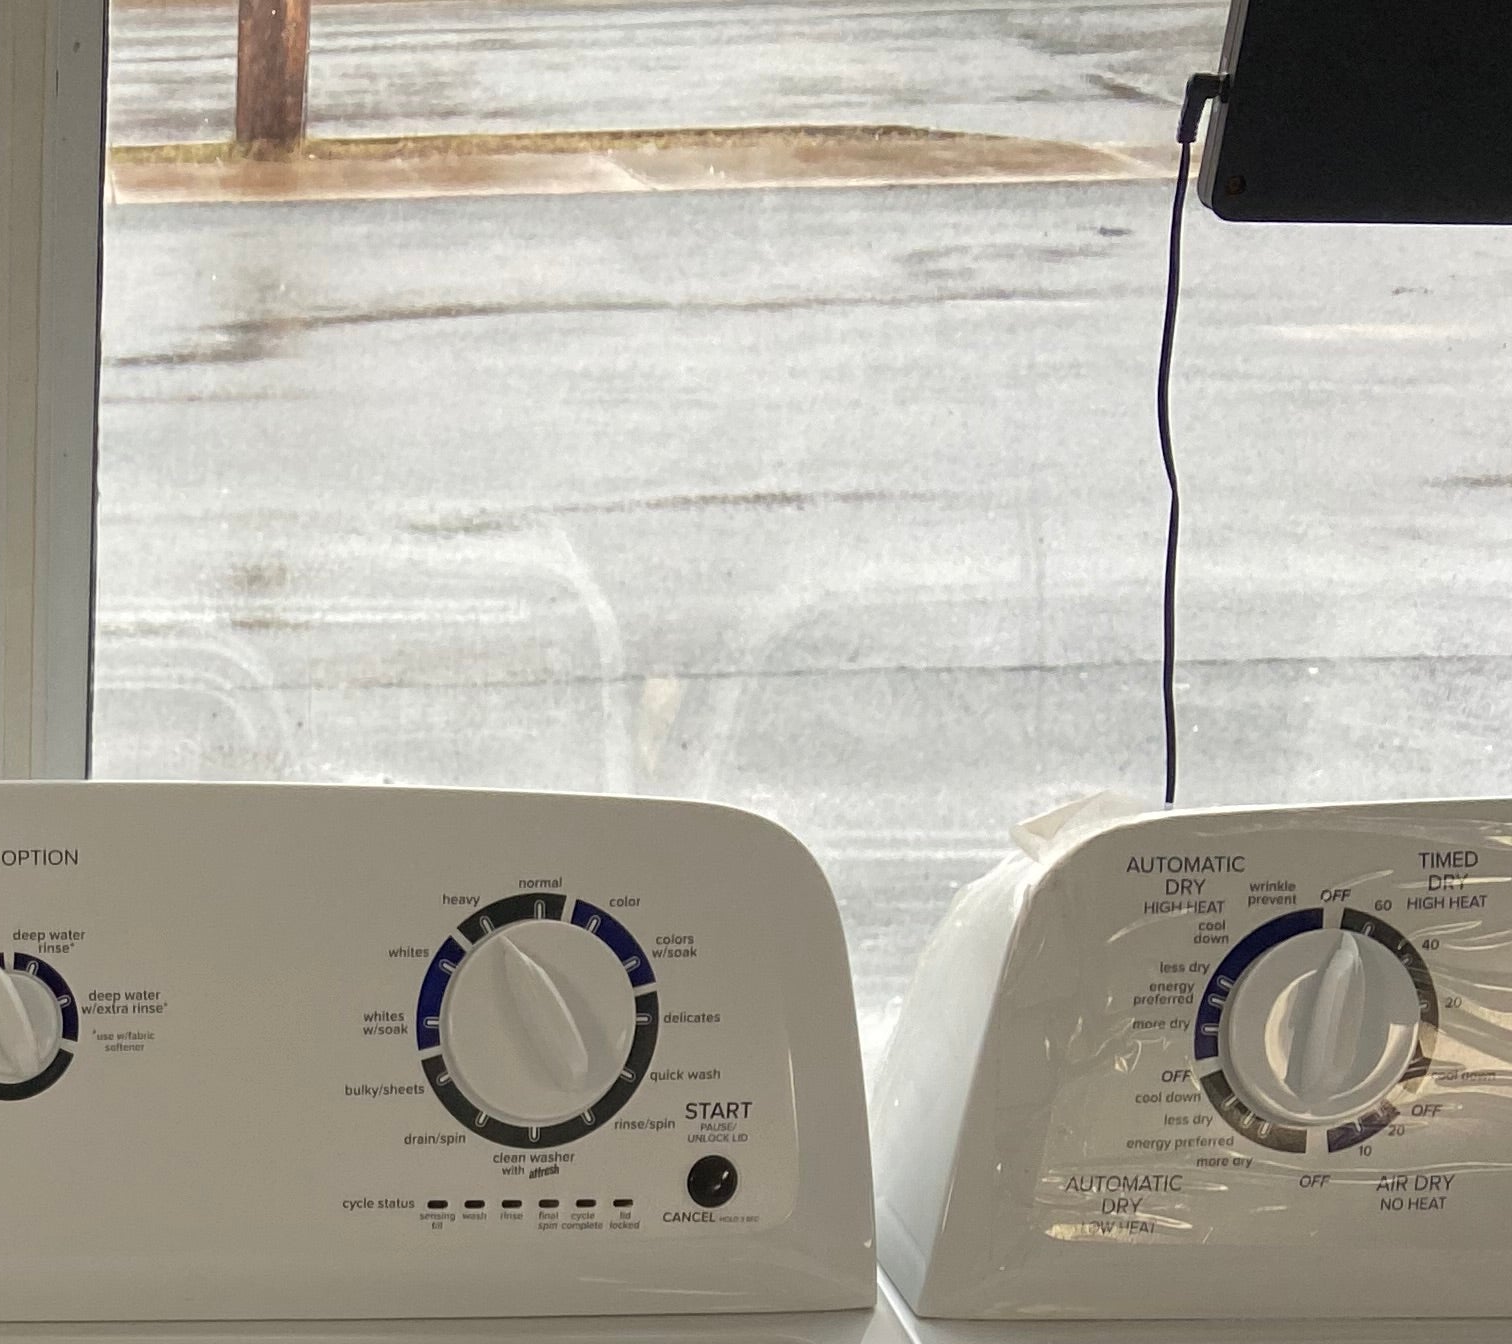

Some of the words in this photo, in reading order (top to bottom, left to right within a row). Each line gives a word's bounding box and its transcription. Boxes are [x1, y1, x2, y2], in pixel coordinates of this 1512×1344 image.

[1, 849, 79, 867] OPTION
[1126, 855, 1246, 874] AUTOMATIC
[1418, 851, 1479, 869] TIMED
[518, 877, 563, 889] normal
[1165, 878, 1206, 896] DRY
[1249, 880, 1296, 892] wrinkle
[1428, 873, 1468, 891] DRY
[442, 894, 480, 907] heavy
[609, 896, 641, 908] color
[1248, 894, 1297, 908] prevent
[1320, 889, 1351, 902] OFF
[1144, 901, 1182, 914] HIGH
[1187, 900, 1225, 914] HEAT
[1375, 900, 1392, 912] 60
[1407, 897, 1444, 910] HIGH
[1449, 895, 1487, 910] HEAT
[1198, 919, 1226, 931] cool
[12, 929, 45, 943] deep
[49, 929, 86, 941] water
[656, 934, 694, 946] colors
[1193, 932, 1229, 944] down
[1422, 939, 1440, 950] 40
[388, 946, 430, 958] whites
[652, 946, 697, 958] w/soak
[1160, 962, 1185, 974] less
[1189, 962, 1210, 974] dry
[1149, 982, 1195, 994] energy
[88, 990, 121, 1004] deep
[124, 990, 161, 1001] water
[1133, 994, 1194, 1006] preferred
[1445, 997, 1462, 1008] 20
[81, 1003, 128, 1015] w/extra
[363, 1011, 405, 1022] whites
[663, 1012, 721, 1024] delicates
[363, 1024, 408, 1036] w/soak
[1132, 1019, 1166, 1030] more
[1170, 1018, 1190, 1031] dry
[649, 1069, 684, 1083] quick
[688, 1069, 721, 1080] wash
[1161, 1069, 1192, 1082] OFF
[345, 1084, 425, 1098] bulky/sheets
[1135, 1092, 1162, 1104] cool
[1166, 1091, 1201, 1103] down
[685, 1101, 752, 1120] START
[1411, 1104, 1442, 1117] OFF
[614, 1117, 675, 1132] rinse/spin
[1164, 1114, 1189, 1125] less
[1193, 1114, 1213, 1127] dry
[1388, 1125, 1405, 1136] 20
[404, 1134, 466, 1148] drain/spin
[687, 1133, 729, 1143] UNLOCK
[731, 1133, 748, 1142] LID
[1126, 1138, 1171, 1151] energy
[1174, 1136, 1234, 1150] preferred
[493, 1152, 526, 1163] clean
[530, 1151, 575, 1163] washer
[1359, 1146, 1372, 1156] 10
[1196, 1157, 1228, 1167] more
[1232, 1156, 1253, 1168] dry
[502, 1165, 525, 1175] with
[1065, 1175, 1183, 1192] AUTOMATIC
[1299, 1175, 1330, 1188] OFF
[1376, 1175, 1408, 1192] AIR
[1414, 1175, 1455, 1191] DRY
[342, 1198, 374, 1211] cycle
[378, 1199, 415, 1209] status
[1102, 1198, 1143, 1215] DRY
[1380, 1198, 1404, 1211] NO
[1408, 1197, 1447, 1210] HEAT
[663, 1212, 716, 1223] CANCEL
